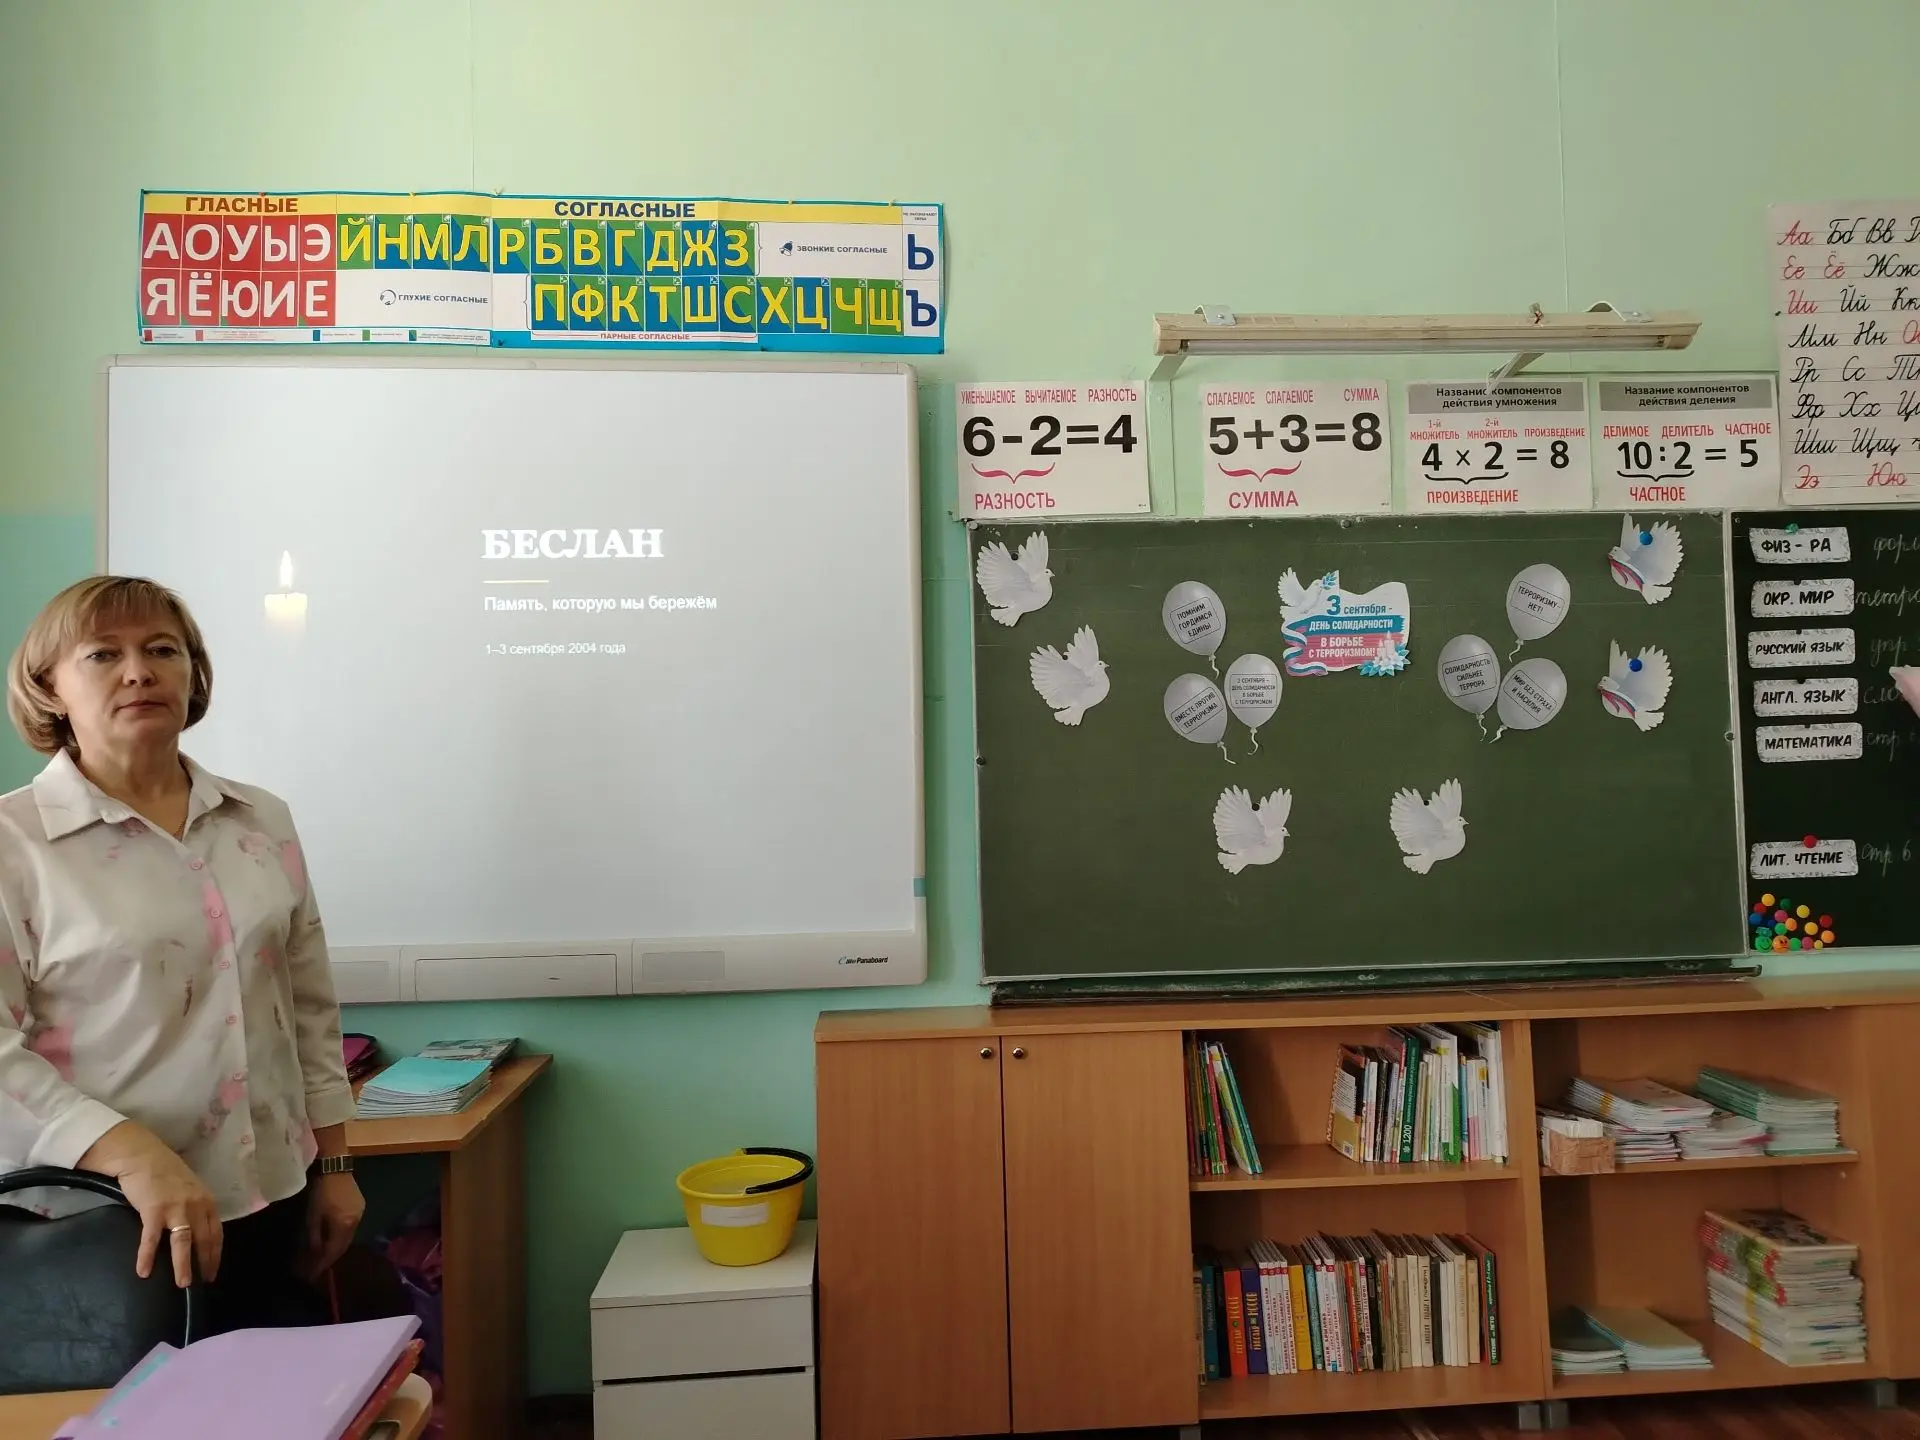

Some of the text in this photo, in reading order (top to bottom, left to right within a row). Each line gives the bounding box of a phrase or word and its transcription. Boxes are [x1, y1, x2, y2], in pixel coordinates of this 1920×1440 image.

[185, 197, 299, 213] ГЛАСНЫЕ
[554, 201, 696, 218] СОГЛАСНЫЕ
[1777, 220, 1814, 245] Аа
[1866, 218, 1896, 244] Вв
[796, 245, 888, 255] ЗВОНКИЕ СОГЛАСНЫЕ
[398, 293, 489, 305] ГЛУХИЕ СОГЛАСНЫЕ
[1788, 289, 1819, 314] Ии
[1840, 284, 1871, 312] Йй
[600, 332, 691, 341] ПАРНЫЕ СОГЛАСНЫЕ
[1788, 320, 1888, 348] Мм Нн
[1790, 355, 1866, 393] Рр Сс
[960, 388, 1137, 404] УМЕНЬШАЕМОЕ ВЫЧИТАЕМОЕ РАЗНОСТЬ
[1207, 388, 1380, 406] СЛАГАЕМОЕ СЛАГАЕМОЕ СУММА
[1491, 386, 1562, 396] компонентов
[1624, 384, 1750, 396] Название компонентов
[1442, 397, 1557, 408] действия умножения
[1638, 395, 1736, 407] действия деления
[1839, 391, 1882, 417] Хх
[1410, 427, 1586, 441] МНОЖИТЕЛЬ МНОЖИТЕЛЬ ПРОИЗВЕДЕНИЕ
[1603, 422, 1772, 439] ДЕЛИМОЕ ДЕЛИТЕЛЬ ЧАСТНОЕ
[1794, 428, 1838, 454] Шш
[1852, 427, 1901, 459] Щщ
[1867, 462, 1908, 487] Юю
[975, 492, 1055, 510] РАЗНОСТЬ
[1229, 490, 1299, 509] СУММА
[1427, 489, 1519, 505] ПРОИЗВЕДЕНИЕ
[1630, 486, 1686, 502] ЧАСТНОЕ
[481, 528, 665, 559] БЕСЛАН
[484, 594, 718, 614] Память, которую мы бережём
[1326, 595, 1386, 616] 3 сентября
[1763, 590, 1835, 606] ОКР. МИР
[1176, 603, 1206, 620] ПОМНИМ
[1527, 601, 1544, 613] НЕТ!
[1178, 610, 1213, 630] ГОРДИМСЯ
[1309, 619, 1393, 632] ДЕНЬ СОЛИДАРНОСТИ
[1187, 622, 1212, 637] ЕДИНЫ
[510, 643, 565, 656] сентября
[568, 642, 596, 654] 2004
[600, 643, 626, 656] года
[1320, 636, 1364, 648] В БОРЬБЕ
[1756, 641, 1845, 655] РУССКИЙ ЯЗЫК
[1308, 647, 1376, 658] С ТЕРРОРИЗМОМ!
[1444, 659, 1491, 675] СОЛИДАРНОСТЬ
[1456, 670, 1484, 681] СИЛЬНЕЕ
[1459, 679, 1486, 691] ТЕРРОРА
[1761, 689, 1847, 705] АНГЛ. ЯЗЫК
[1174, 691, 1216, 723] ВМЕСТЕ ПРОТИВ
[1183, 702, 1219, 729] ТЕРРОРИЗМА
[1765, 735, 1852, 750] МАТЕМАТИКА
[1760, 851, 1844, 867] ЛИТ. ЧТЕНИЕ
[1403, 1124, 1412, 1144] 1200
